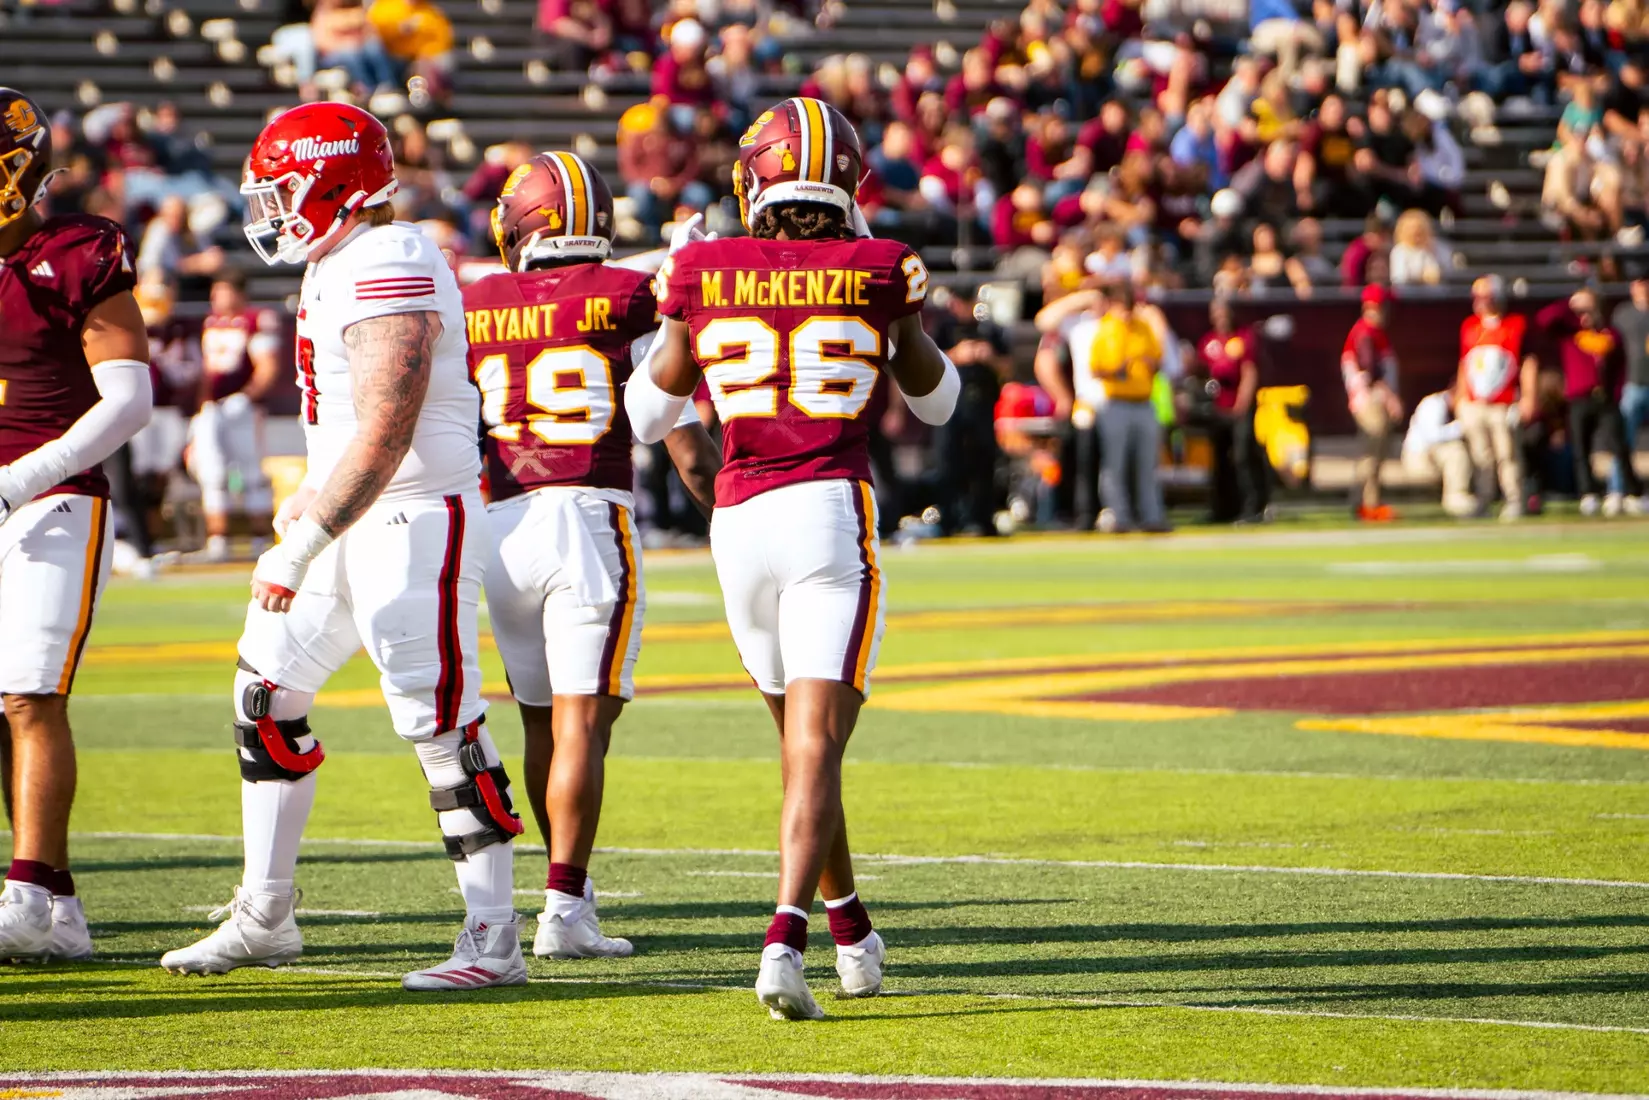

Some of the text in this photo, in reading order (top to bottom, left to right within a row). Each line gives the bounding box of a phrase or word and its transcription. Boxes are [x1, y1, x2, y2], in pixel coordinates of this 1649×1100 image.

[290, 131, 359, 162] Miami
[564, 239, 596, 248] BRAVERY
[701, 270, 729, 307] M.
[734, 269, 872, 306] McKENZIE
[576, 296, 617, 332] JR.
[696, 315, 881, 424] 26
[474, 344, 616, 445] 19
